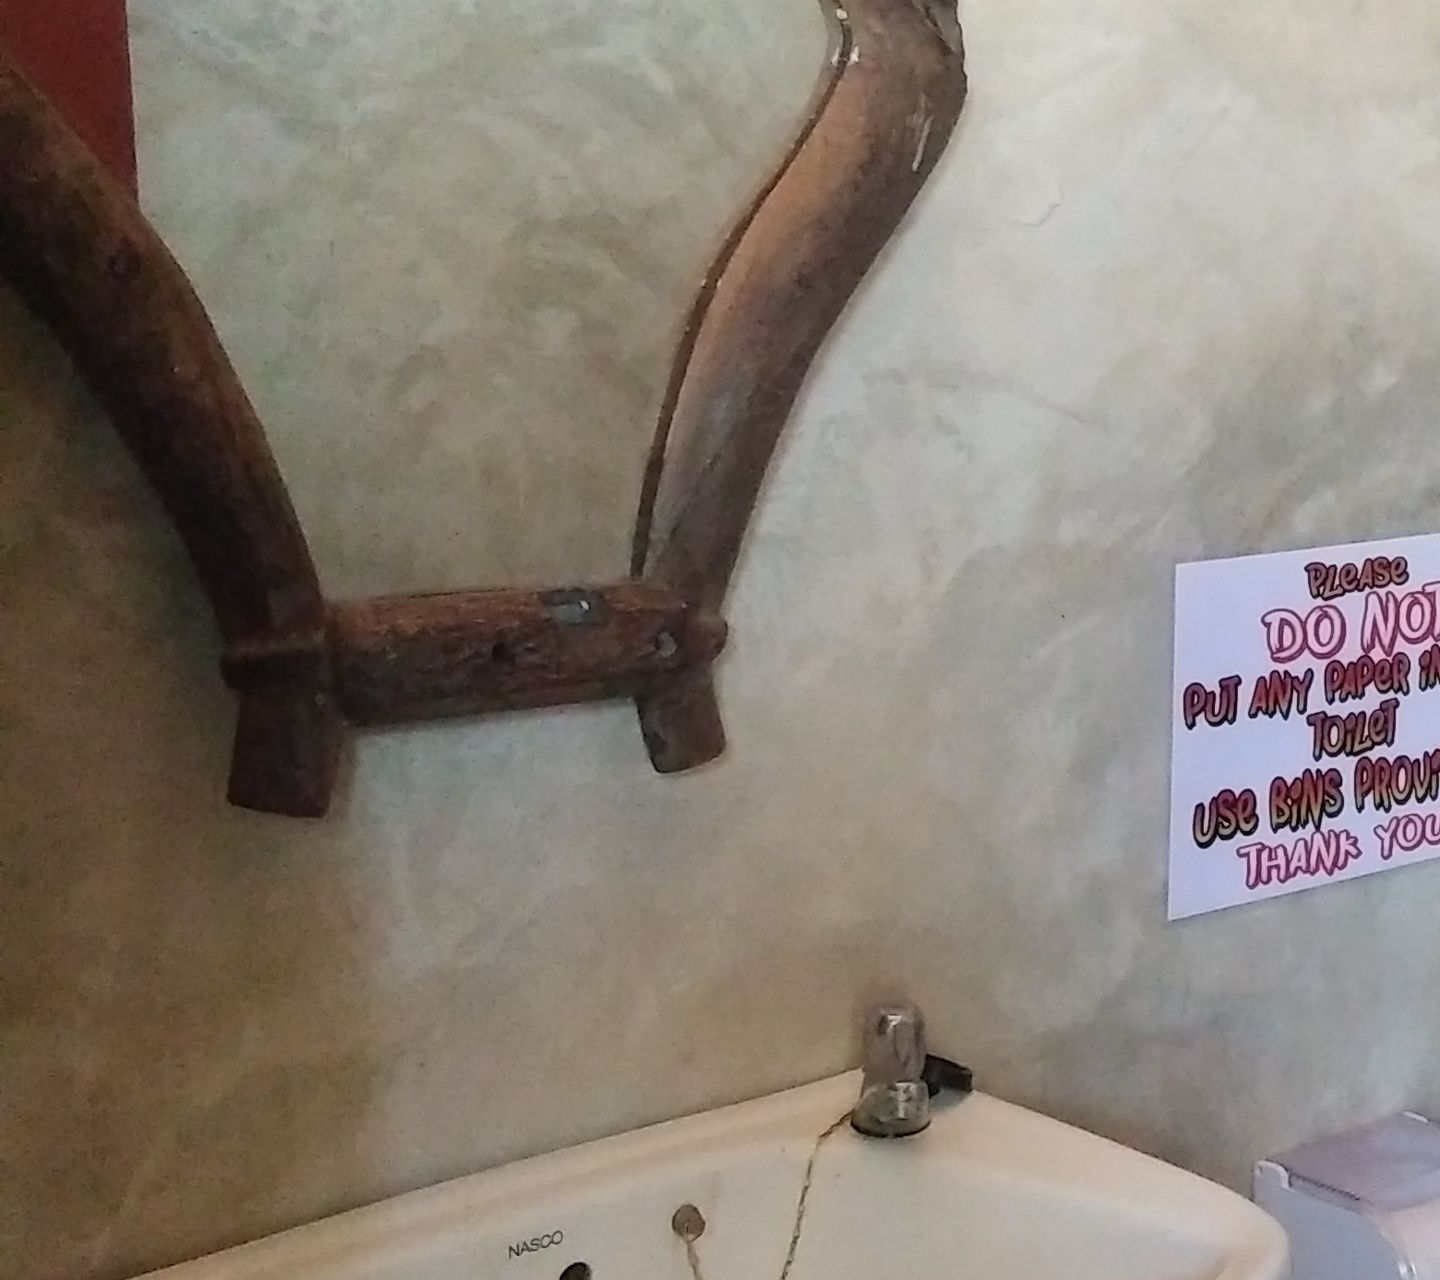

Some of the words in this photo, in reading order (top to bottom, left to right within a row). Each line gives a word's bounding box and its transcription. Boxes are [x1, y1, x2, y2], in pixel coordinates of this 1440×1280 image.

[1261, 605, 1347, 663] DO
[1183, 675, 1241, 730] PUT
[1249, 668, 1313, 720] ANY
[1237, 830, 1362, 890] THANK
[508, 1230, 564, 1260] NASCO
